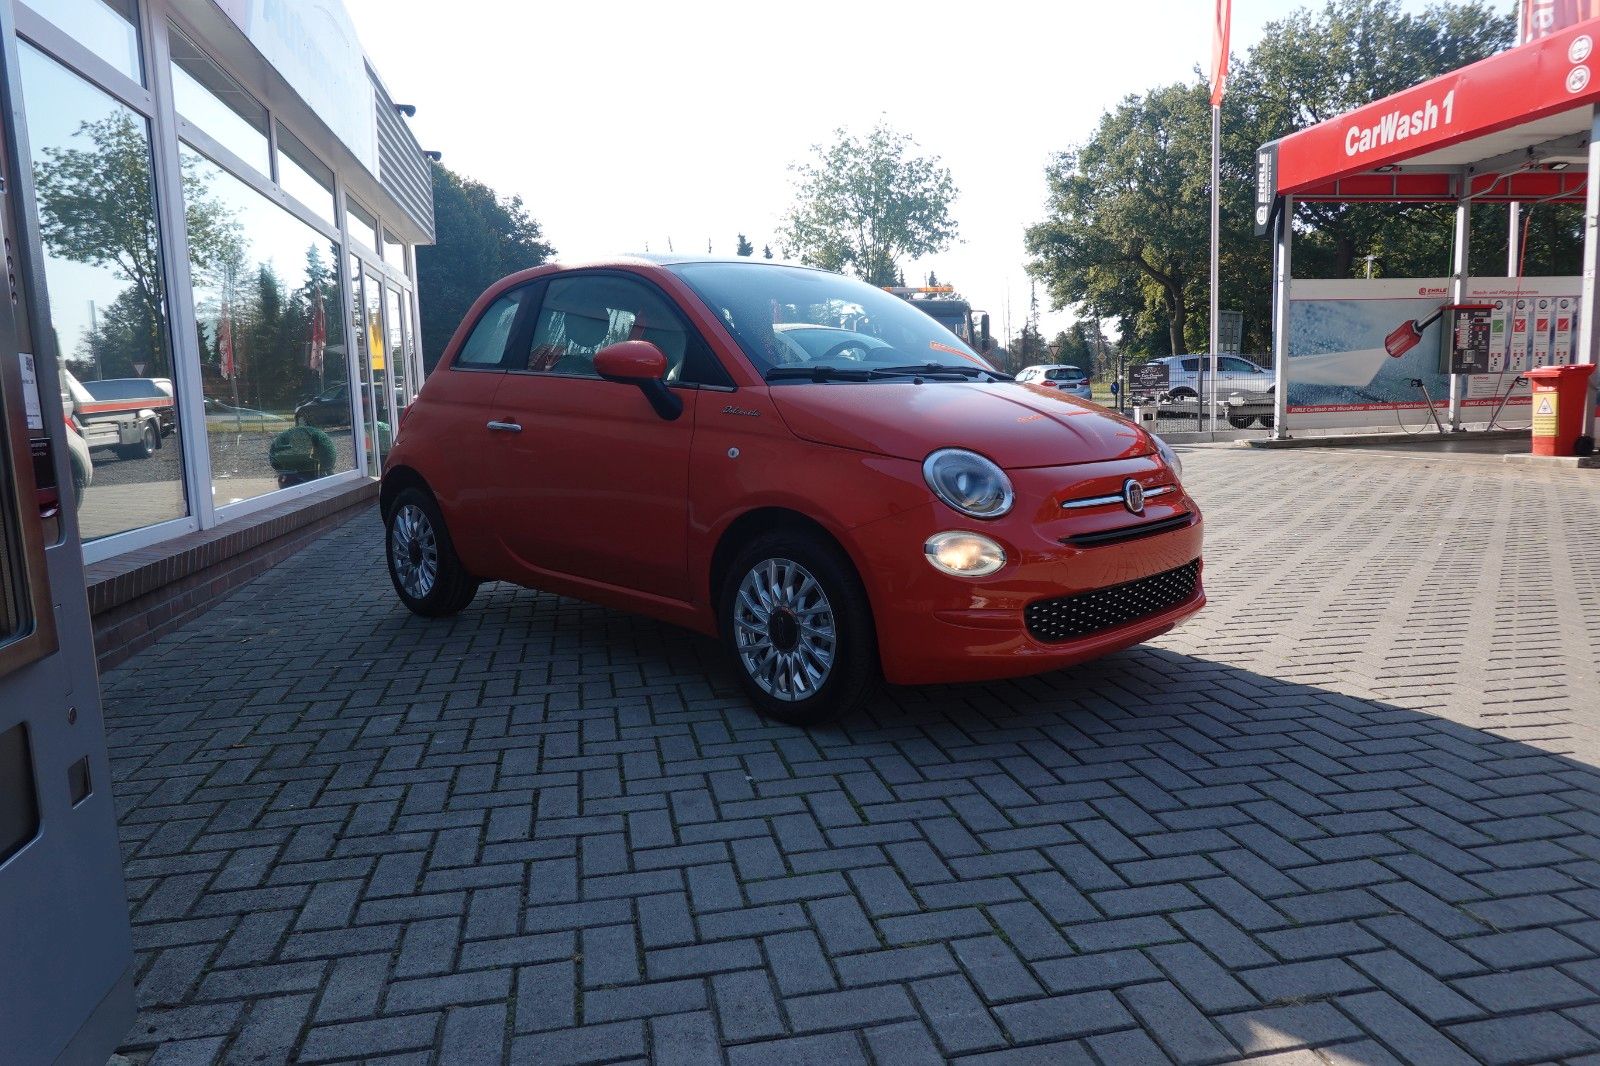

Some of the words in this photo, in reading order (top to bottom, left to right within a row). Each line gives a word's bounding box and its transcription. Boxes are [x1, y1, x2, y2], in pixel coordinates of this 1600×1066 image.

[1345, 99, 1439, 156] CarWash
[1442, 90, 1455, 124] 1
[1258, 153, 1266, 203] EHRLE
